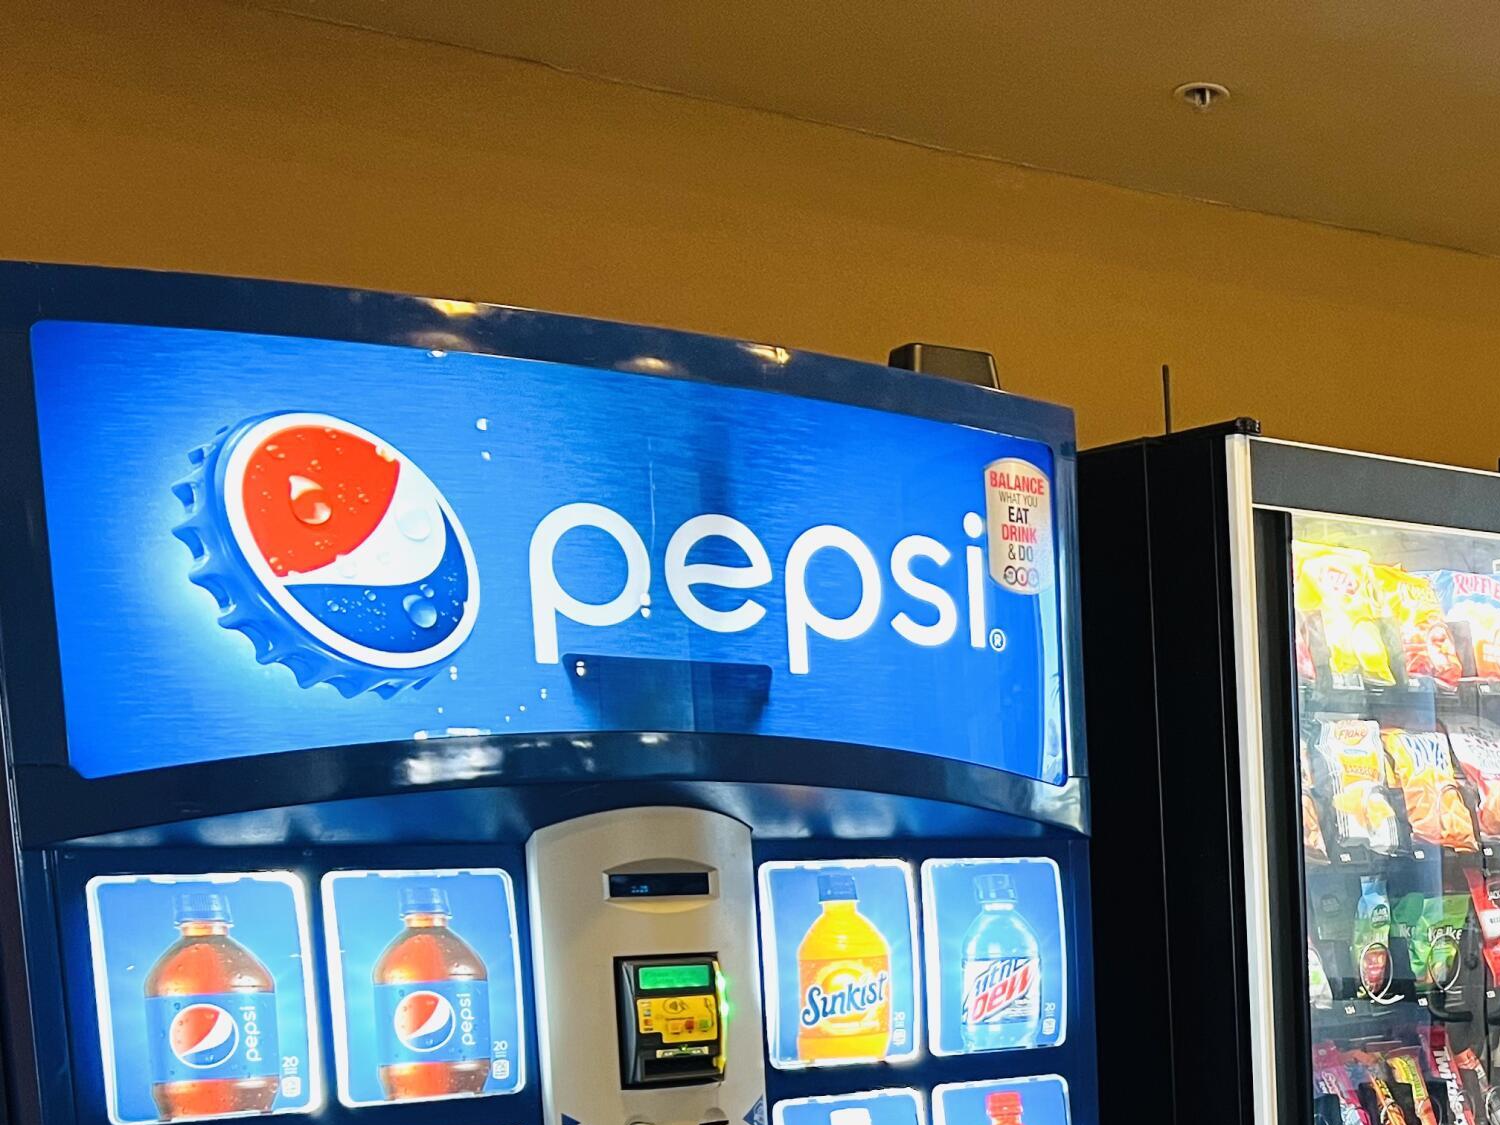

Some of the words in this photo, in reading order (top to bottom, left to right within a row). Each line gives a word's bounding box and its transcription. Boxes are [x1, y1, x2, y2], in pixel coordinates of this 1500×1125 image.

[989, 470, 1045, 496] BALANCE
[998, 490, 1021, 504] WHAT
[1022, 496, 1038, 508] YOU
[1008, 505, 1030, 525] EAT
[1001, 524, 1038, 544] DRINK
[1008, 543, 1016, 561] &
[1018, 543, 1034, 562] DO
[528, 501, 988, 675] pepsi
[801, 972, 888, 1026] Sunkist
[456, 992, 476, 1046] pepsi
[239, 1005, 262, 1062] pepsi
[493, 1040, 508, 1051] 20
[282, 1055, 299, 1067] 20
